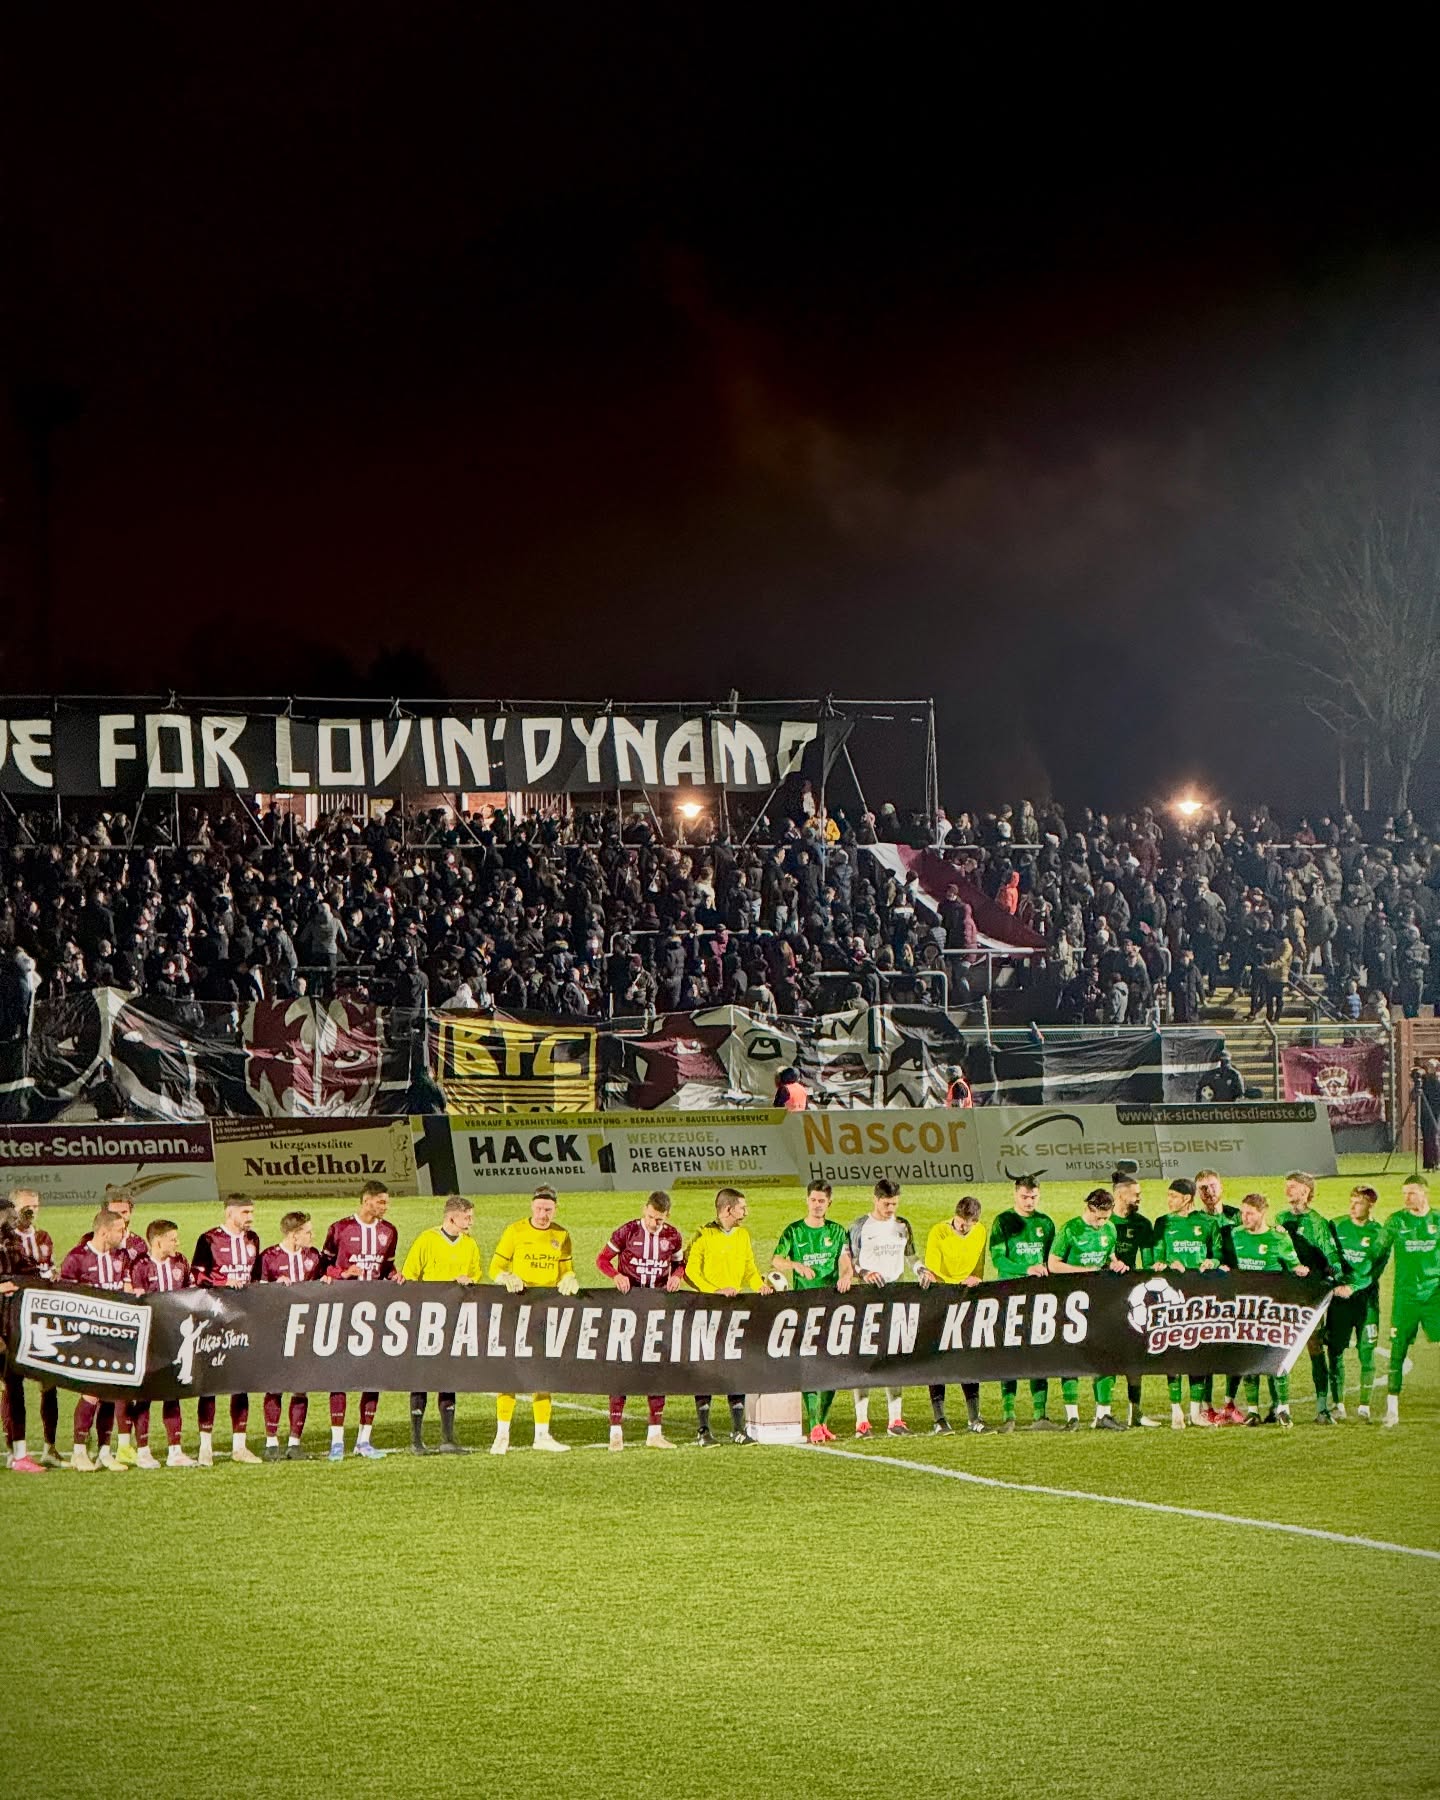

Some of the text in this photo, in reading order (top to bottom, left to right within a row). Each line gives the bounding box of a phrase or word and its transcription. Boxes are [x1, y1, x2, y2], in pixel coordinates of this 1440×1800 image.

[99, 714, 249, 789] FOR
[453, 1023, 584, 1076] BFC
[465, 1119, 502, 1128] VERKAUF
[514, 1118, 569, 1127] VERMIETUNG
[577, 1117, 621, 1126] BERATUNG
[630, 1116, 676, 1125] REPARATUR
[686, 1114, 769, 1123] BAUSTELLENSERVICE
[1118, 1106, 1315, 1122] www.rk-sicherheitsdienste.de
[627, 1132, 719, 1145] WERKZEUGE,
[802, 1113, 966, 1156] Nascor
[270, 1138, 353, 1152] Kiezgaststätte
[468, 1134, 583, 1165] HACK
[629, 1145, 768, 1159] DIE GENAUSO HART
[1001, 1139, 1244, 1157] RK SICHERHEITSDIENST
[243, 1153, 387, 1177] Nudelholz
[474, 1166, 586, 1177] WERKZEUGHANDEL
[632, 1159, 763, 1173] ARBEITEN WIE DU.
[809, 1160, 974, 1182] Hausverwaltung
[1065, 1161, 1082, 1170] MIT
[1085, 1161, 1104, 1170] UNS
[1145, 1159, 1180, 1169] SICHER
[524, 1253, 559, 1261] ALPHA
[530, 1261, 555, 1269] SUN
[629, 1258, 667, 1268] ALPHA
[636, 1266, 662, 1275] SUN
[31, 1297, 141, 1323] REGIONALLIGA
[1150, 1297, 1315, 1329] Fußballfans
[67, 1321, 138, 1340] NORDOST
[284, 1290, 1090, 1362] FUSSBALLVEREINE GEGEN KREBS
[222, 1329, 249, 1350] Stern
[1151, 1322, 1231, 1351] gegen
